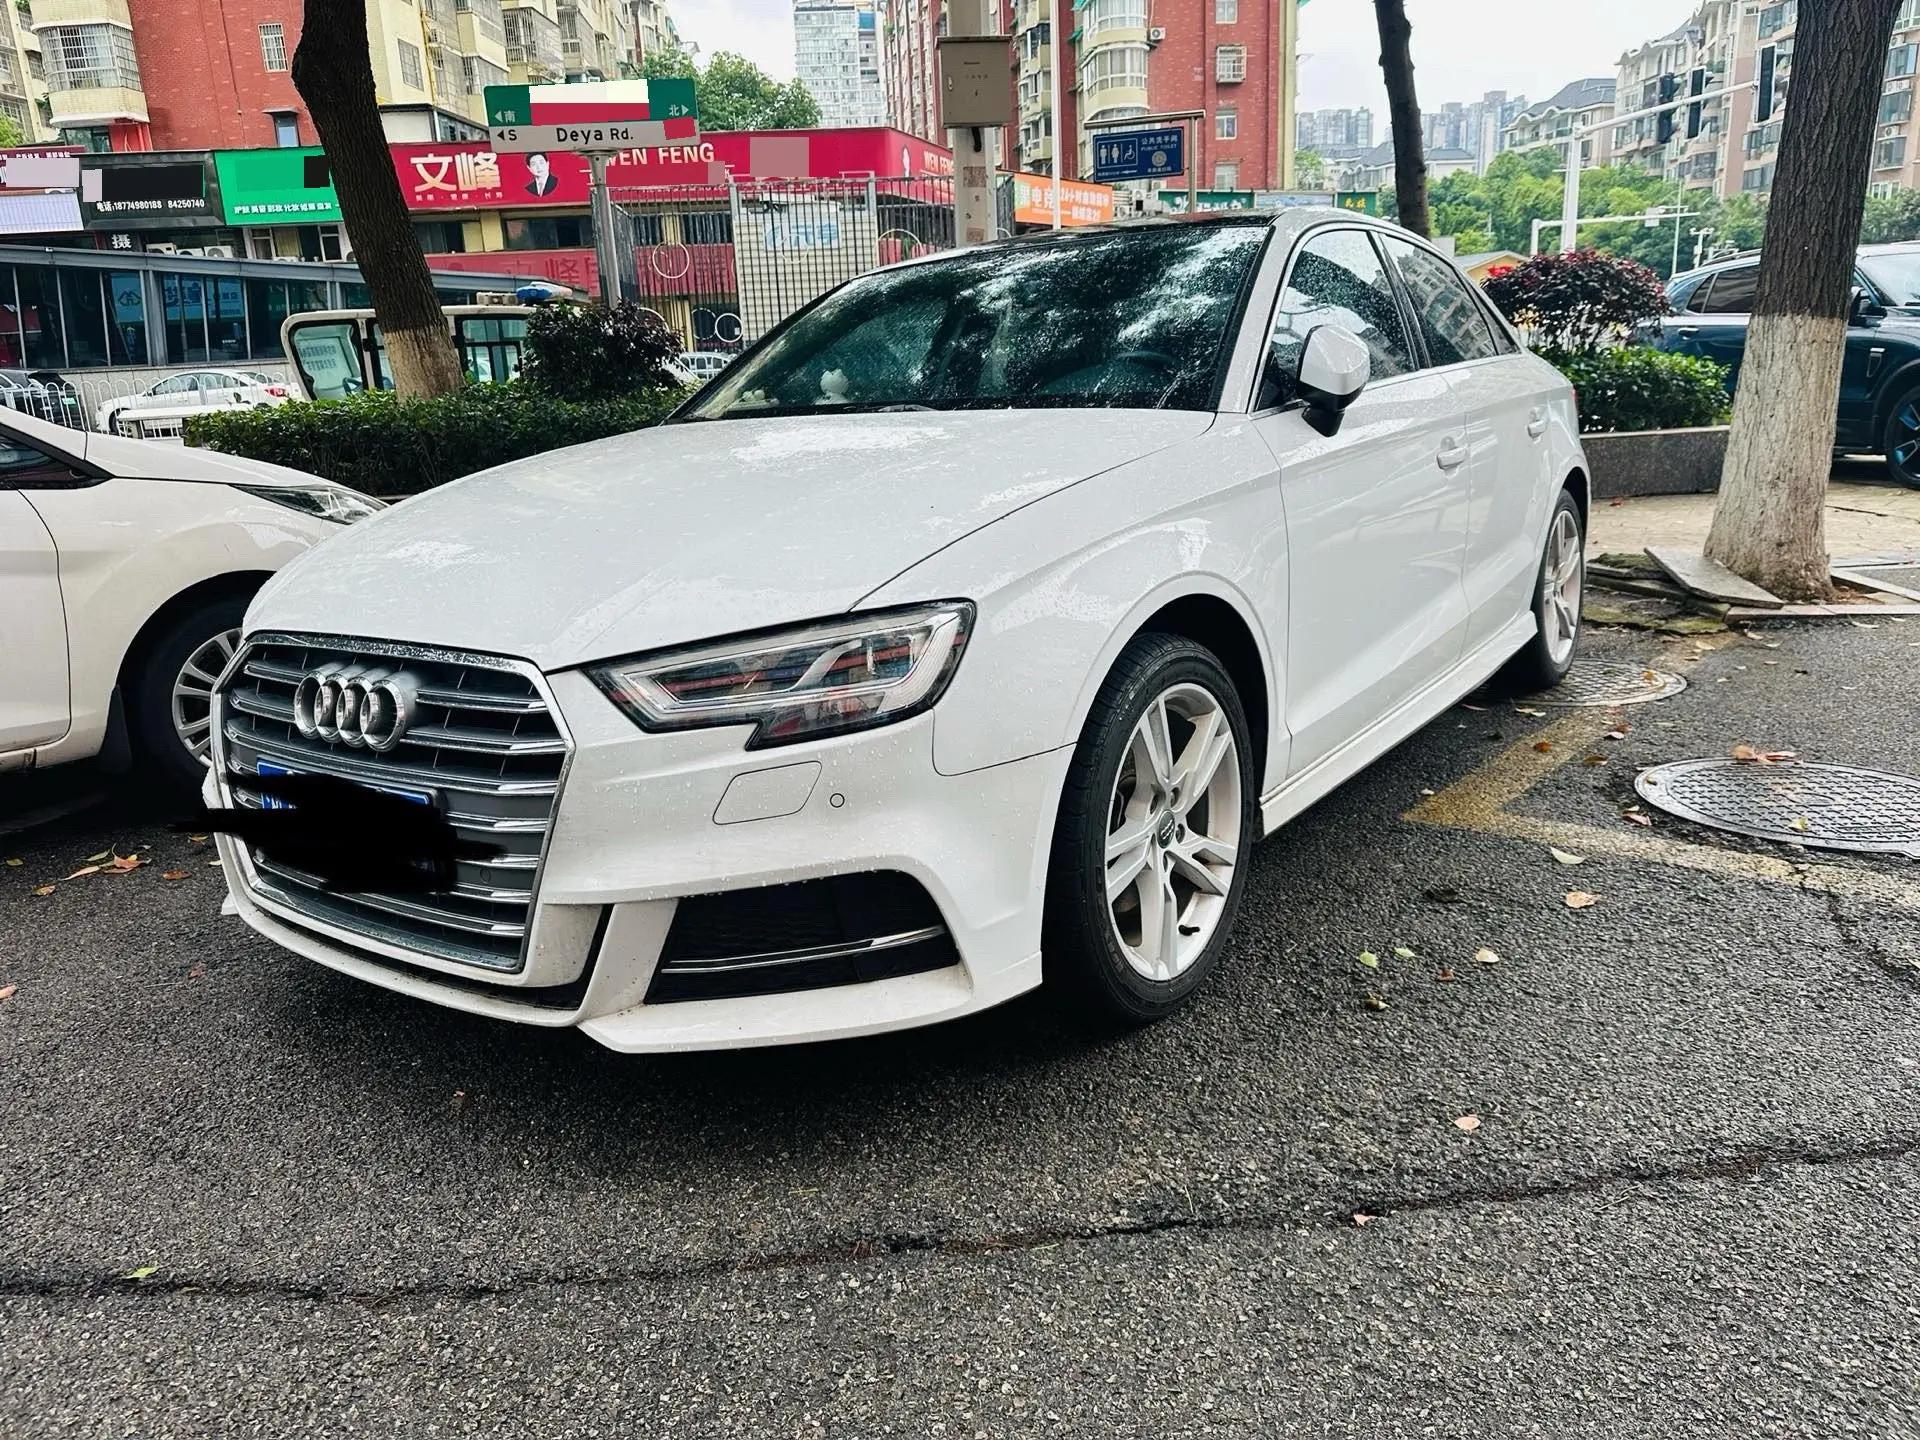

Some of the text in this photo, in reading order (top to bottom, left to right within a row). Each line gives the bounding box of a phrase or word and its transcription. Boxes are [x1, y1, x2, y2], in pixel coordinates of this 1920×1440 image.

[503, 110, 516, 123] 南
[668, 104, 680, 116] 北
[509, 129, 518, 141] S
[556, 126, 634, 145] Deya Rd.
[658, 143, 715, 165] FENG
[923, 150, 940, 174] WEN
[410, 151, 502, 193] 文峰
[168, 199, 205, 209] 84250740
[112, 234, 131, 249] 摄
